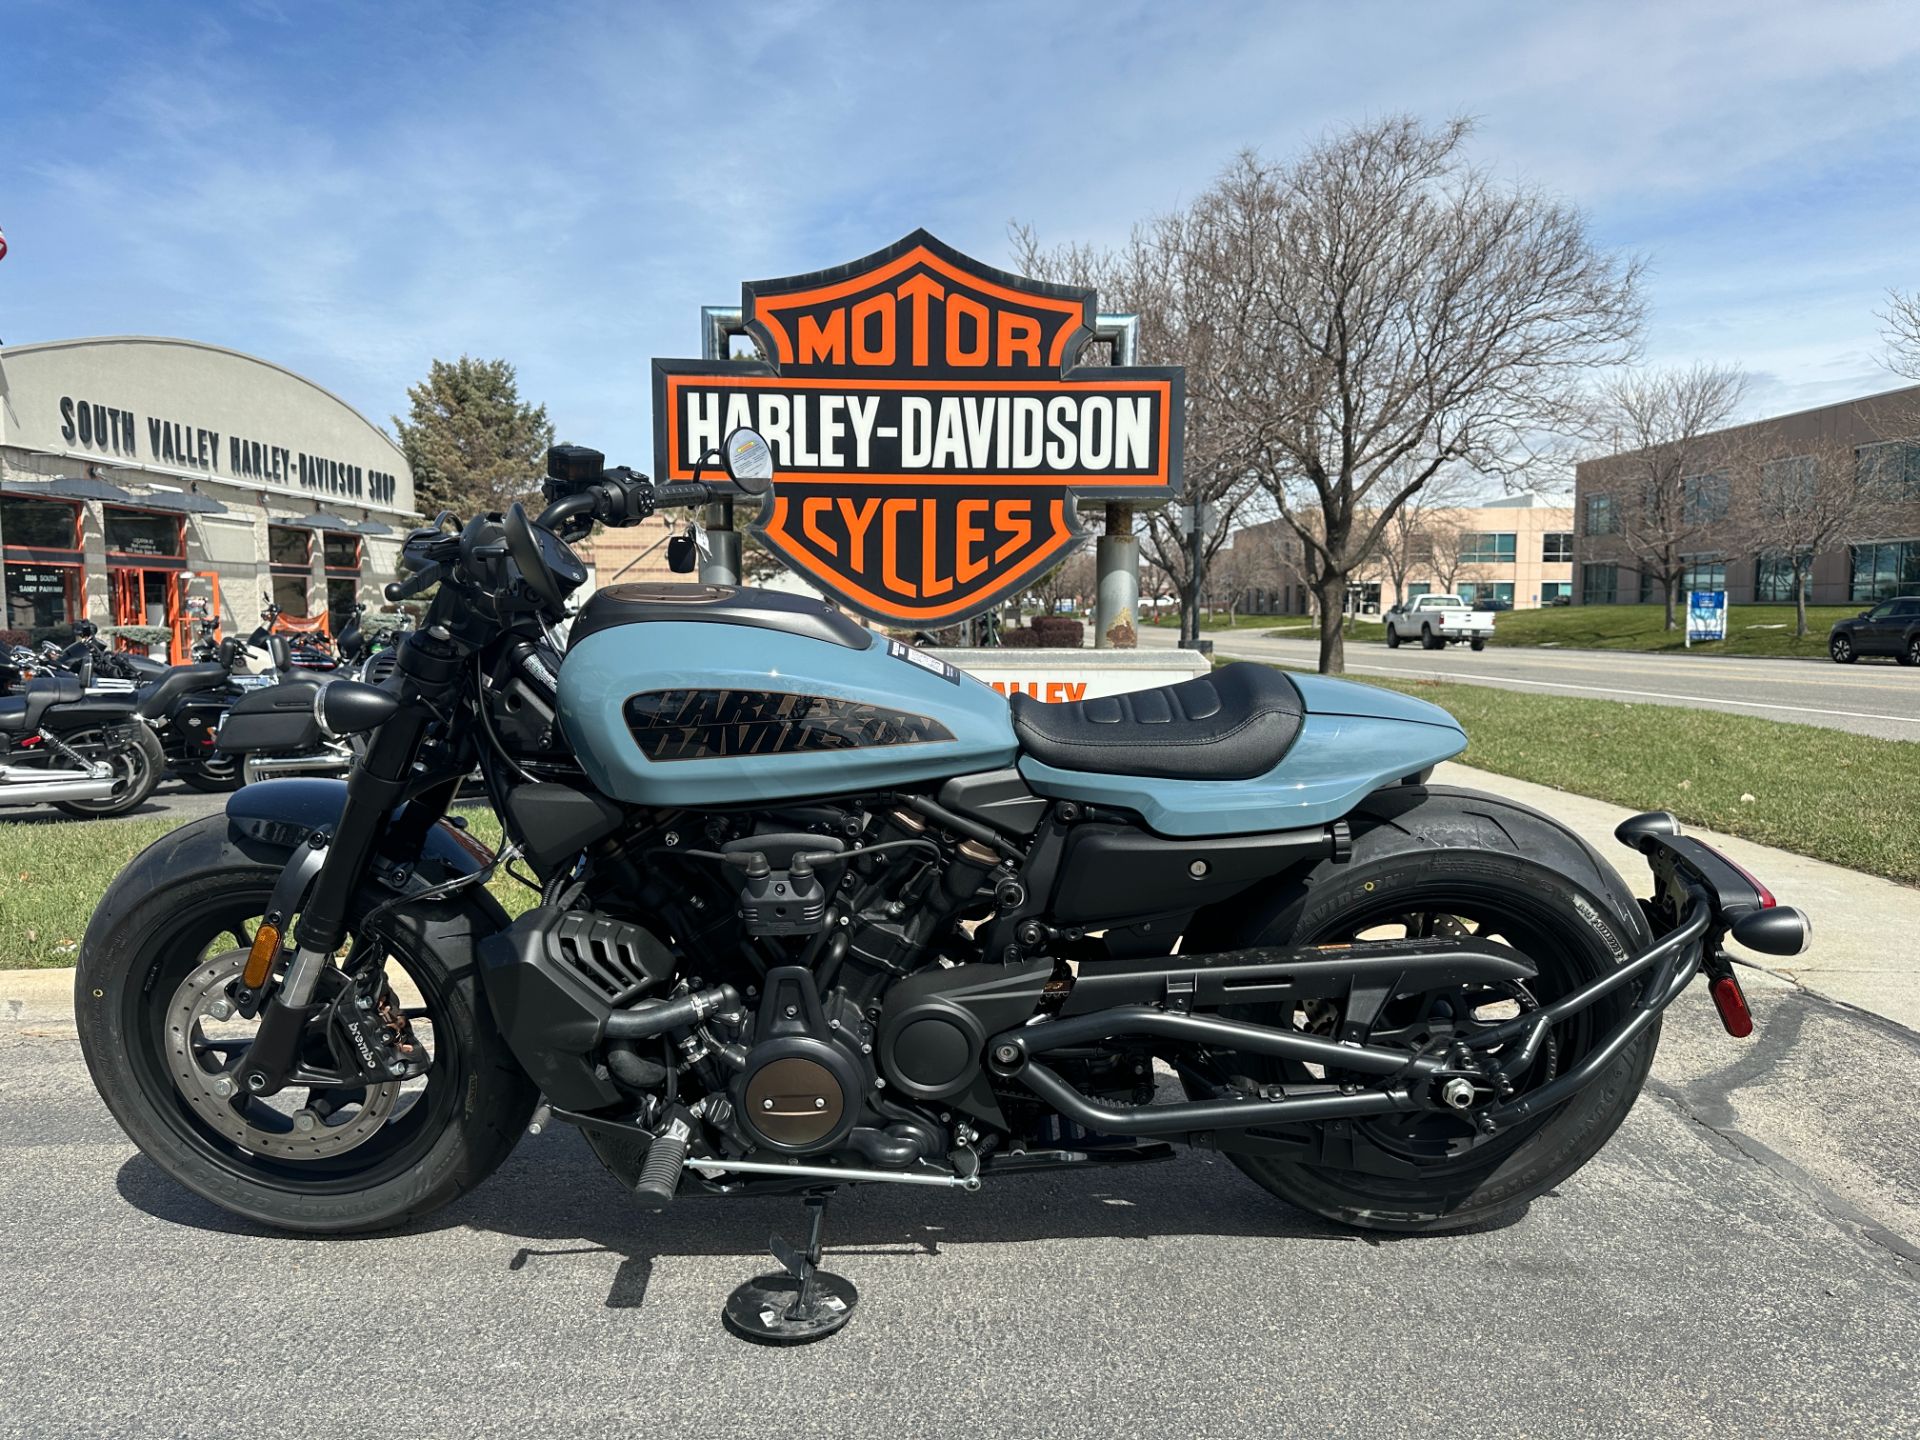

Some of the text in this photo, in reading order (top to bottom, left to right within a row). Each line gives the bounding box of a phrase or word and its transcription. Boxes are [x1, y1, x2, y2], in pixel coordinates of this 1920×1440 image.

[798, 273, 1042, 367] MOTOR
[60, 396, 396, 504] SOUTH VALLEY HARLEY-DAVIDSON SHOP
[802, 497, 1032, 599] CYCLES
[348, 1021, 376, 1069] brembo
